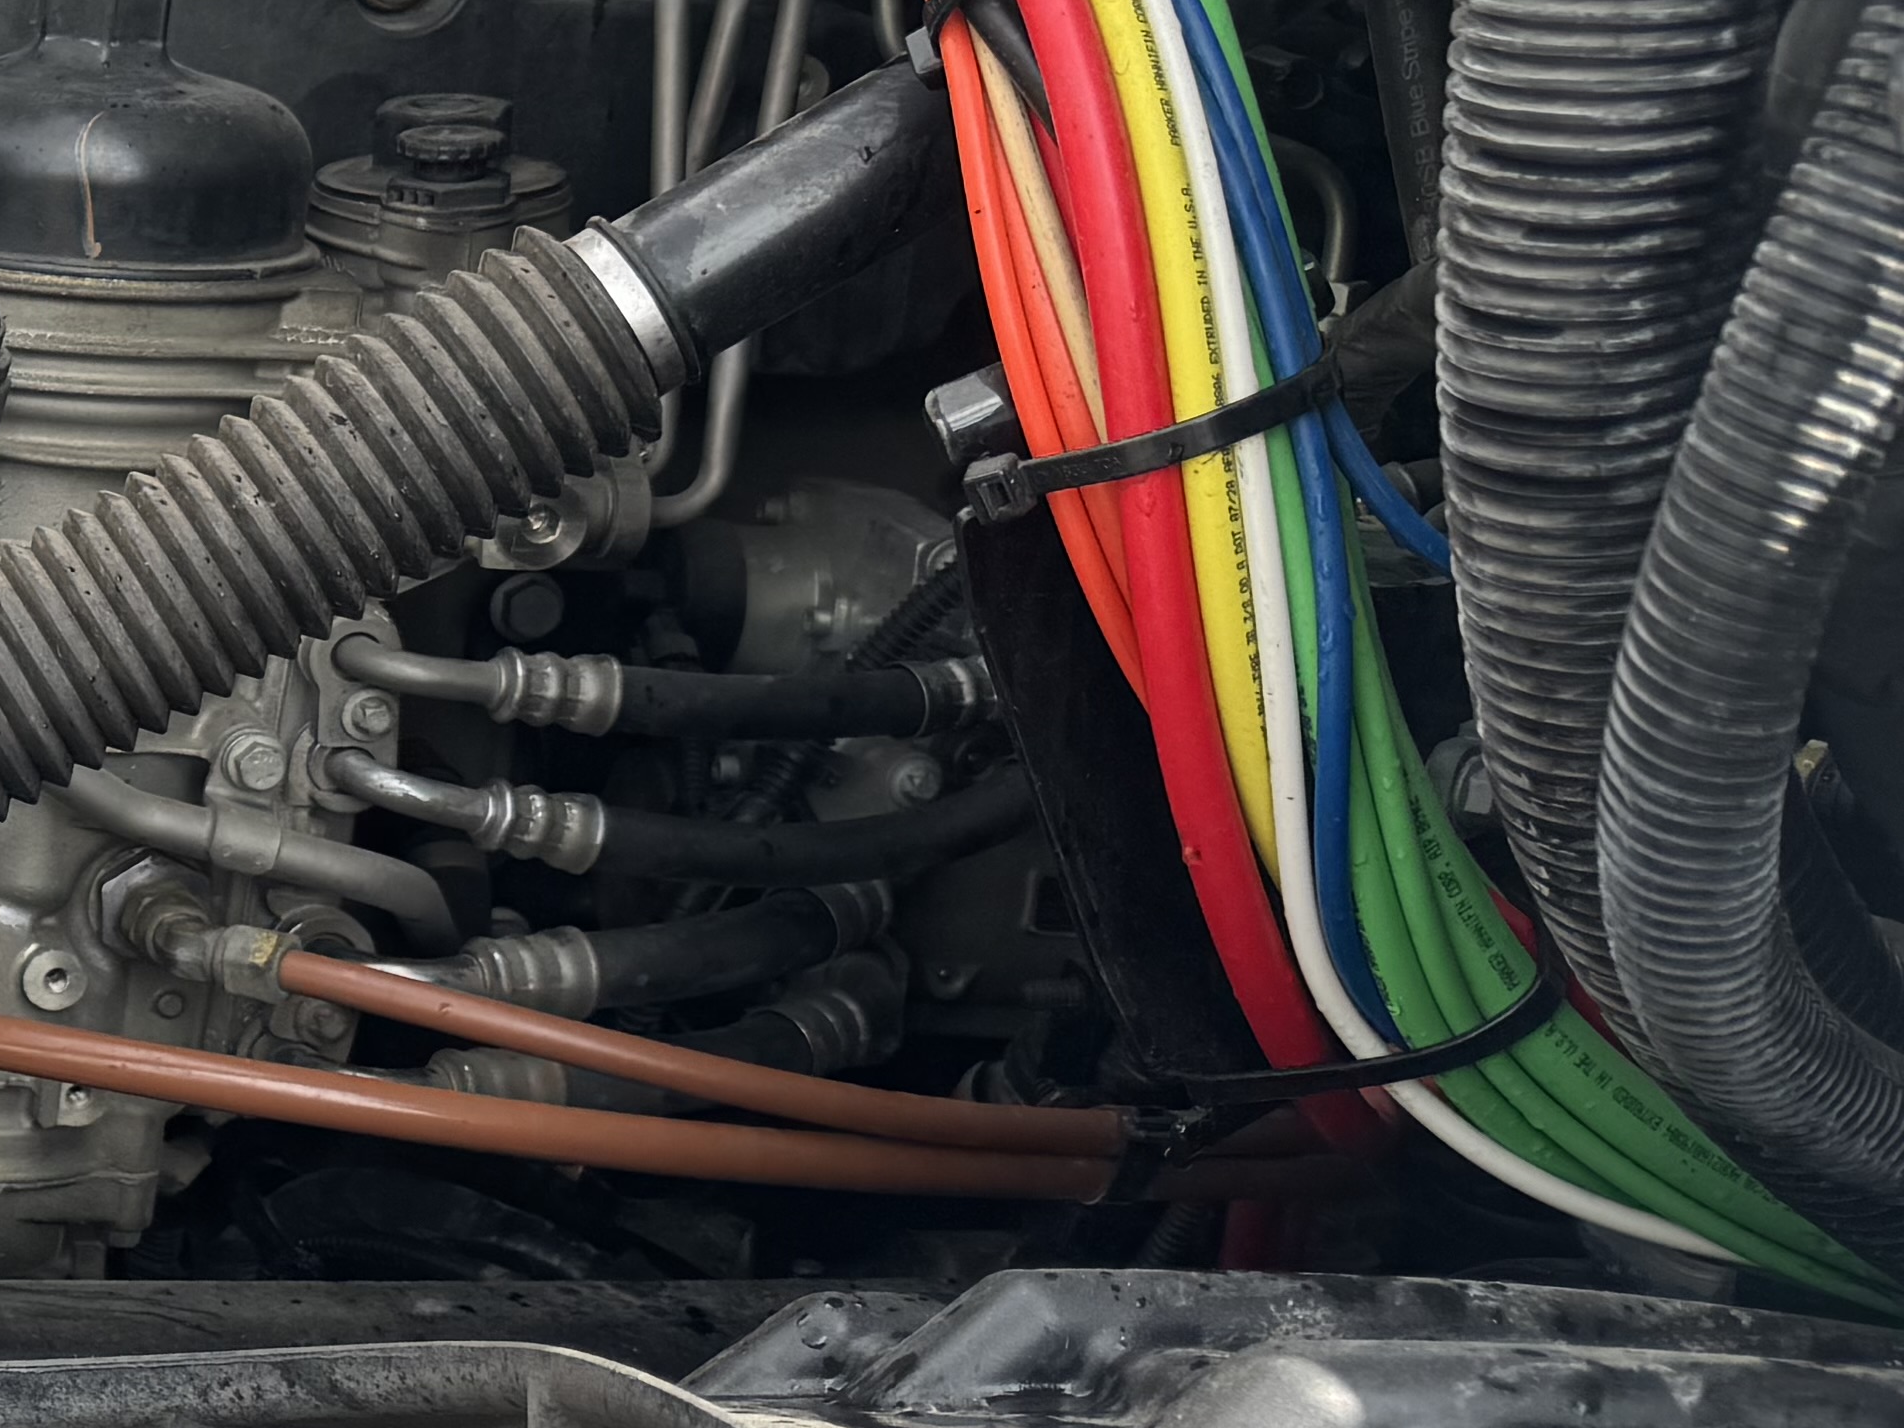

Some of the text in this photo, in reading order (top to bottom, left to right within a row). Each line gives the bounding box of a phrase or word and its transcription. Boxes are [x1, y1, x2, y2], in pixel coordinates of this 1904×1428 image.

[1141, 30, 1168, 90] HANNIFIN
[1396, 7, 1431, 136] Blue Stripe
[1160, 98, 1181, 145] PARKER
[1182, 182, 1198, 227] U.S.A.
[1190, 238, 1204, 259] THE
[1196, 271, 1210, 284] IN
[1200, 296, 1220, 363] EXTRUDED
[1232, 529, 1246, 553] DOT
[1423, 838, 1519, 989] PARKER HANNIFIN AIR
[1573, 1052, 1598, 1077] THE
[1593, 1070, 1612, 1089] IN
[1609, 1085, 1664, 1130] EXTRUDED
